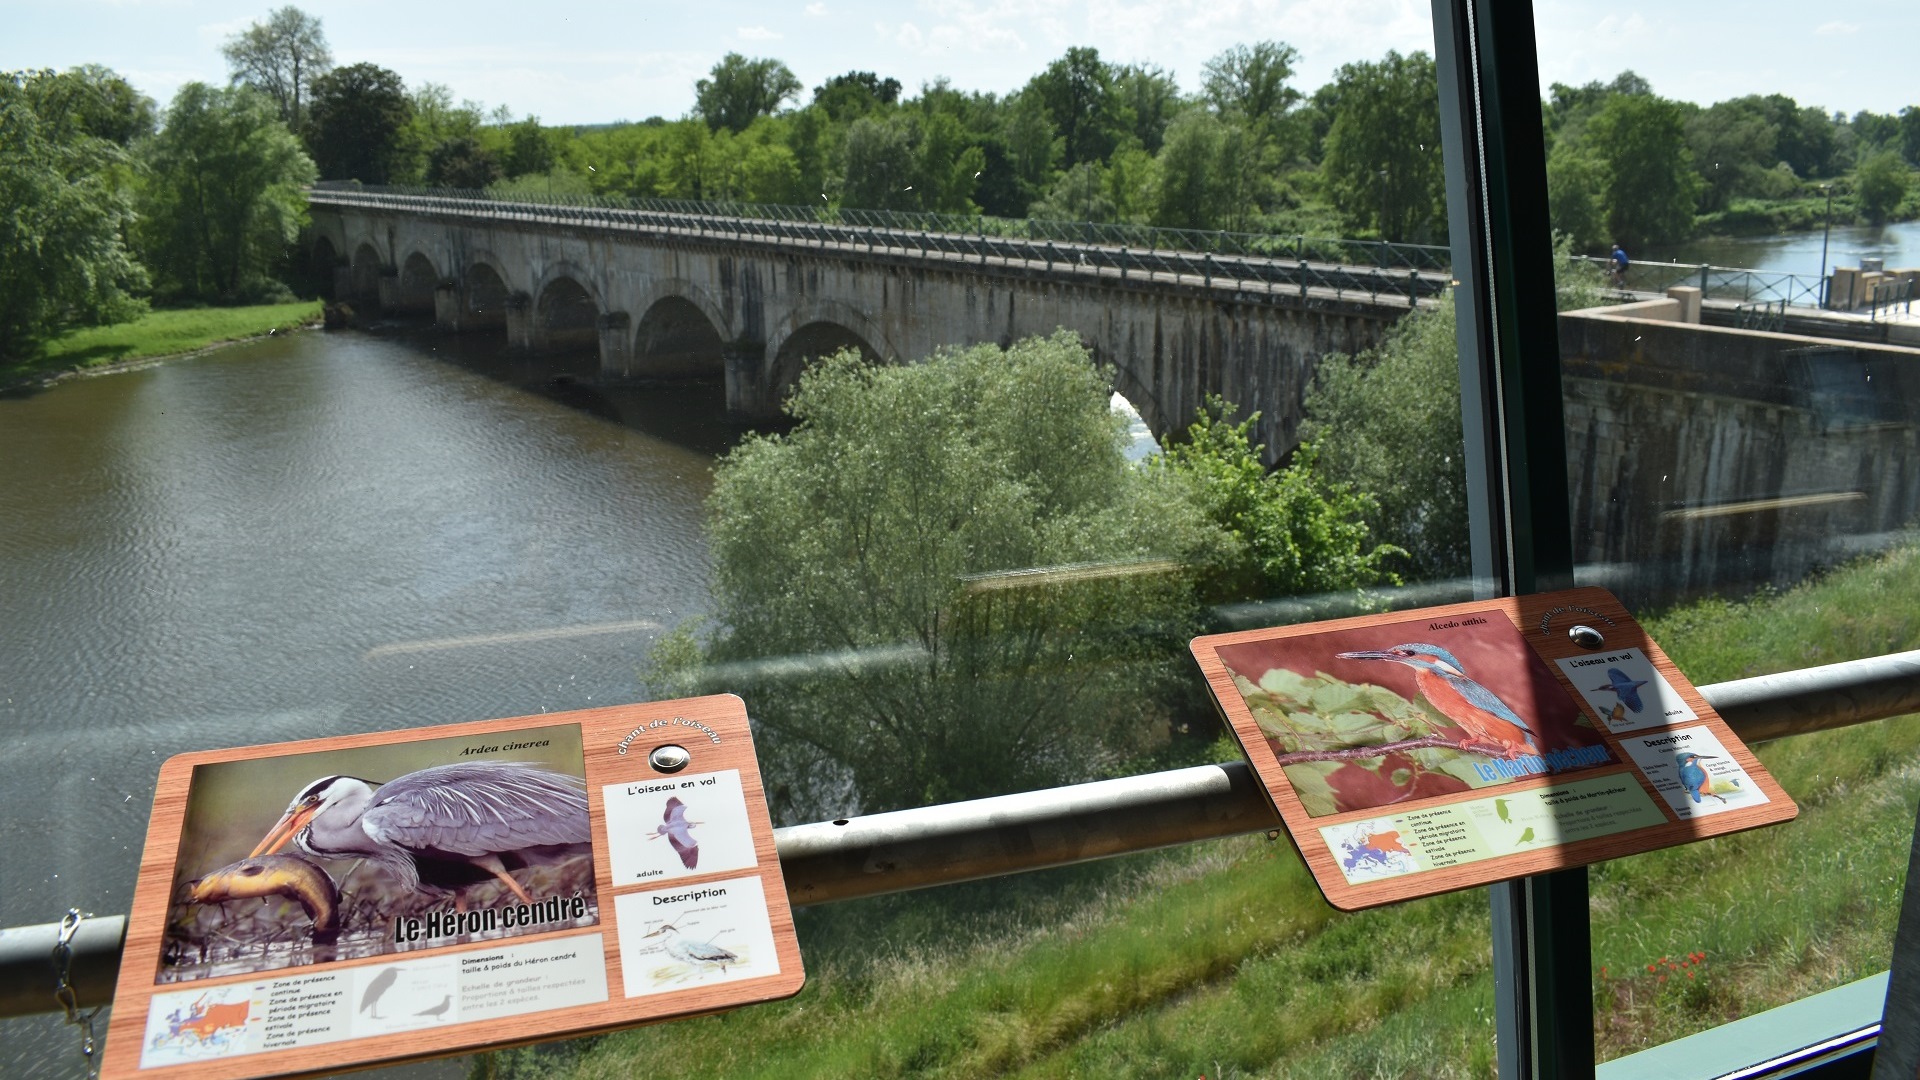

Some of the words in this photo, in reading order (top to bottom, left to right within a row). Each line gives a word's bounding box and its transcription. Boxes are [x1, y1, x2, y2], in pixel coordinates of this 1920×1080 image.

[1428, 620, 1460, 632] Alcedo
[1462, 617, 1487, 627] atthis
[1570, 659, 1606, 669] L'oiseau
[1620, 653, 1633, 661] vol
[618, 725, 646, 755] chant
[649, 720, 667, 729] de
[673, 718, 722, 744] l'oiseau
[1643, 734, 1693, 748] Description
[460, 745, 498, 756] Ardea
[502, 739, 550, 750] cinerea
[1473, 762, 1496, 782] Le
[628, 784, 676, 795] L'oiseau
[700, 777, 716, 786] vol
[1540, 790, 1570, 799] Dimensions
[1435, 823, 1458, 831] présence
[1418, 833, 1438, 841] période
[1439, 829, 1465, 837] migratoire
[1443, 836, 1467, 844] présence
[1453, 848, 1476, 856] présence
[1433, 859, 1457, 867] hivernale
[636, 870, 664, 878] adulte
[653, 889, 727, 905] Description
[395, 916, 420, 943] Le
[426, 908, 496, 939] Héron
[502, 892, 585, 928] cendré
[462, 954, 504, 966] Dimensions
[462, 966, 482, 974] taille
[491, 962, 512, 972] poids
[514, 960, 523, 968] du
[524, 956, 548, 965] Héron
[550, 952, 577, 962] cendré
[303, 976, 336, 985] présence
[462, 983, 490, 992] Echelle
[506, 976, 542, 988] grandeur
[271, 989, 301, 997] continue
[300, 992, 332, 1001] présence
[462, 989, 507, 1002] Proportions
[517, 985, 541, 994] tailles
[269, 1005, 296, 1015] période
[298, 1001, 336, 1010] migratoire
[462, 1003, 484, 1012] entre
[486, 1000, 498, 1008] les
[298, 1009, 331, 1019] présence
[265, 1023, 293, 1031] estivale
[297, 1026, 330, 1036] présence
[263, 1040, 297, 1049] hivernale
